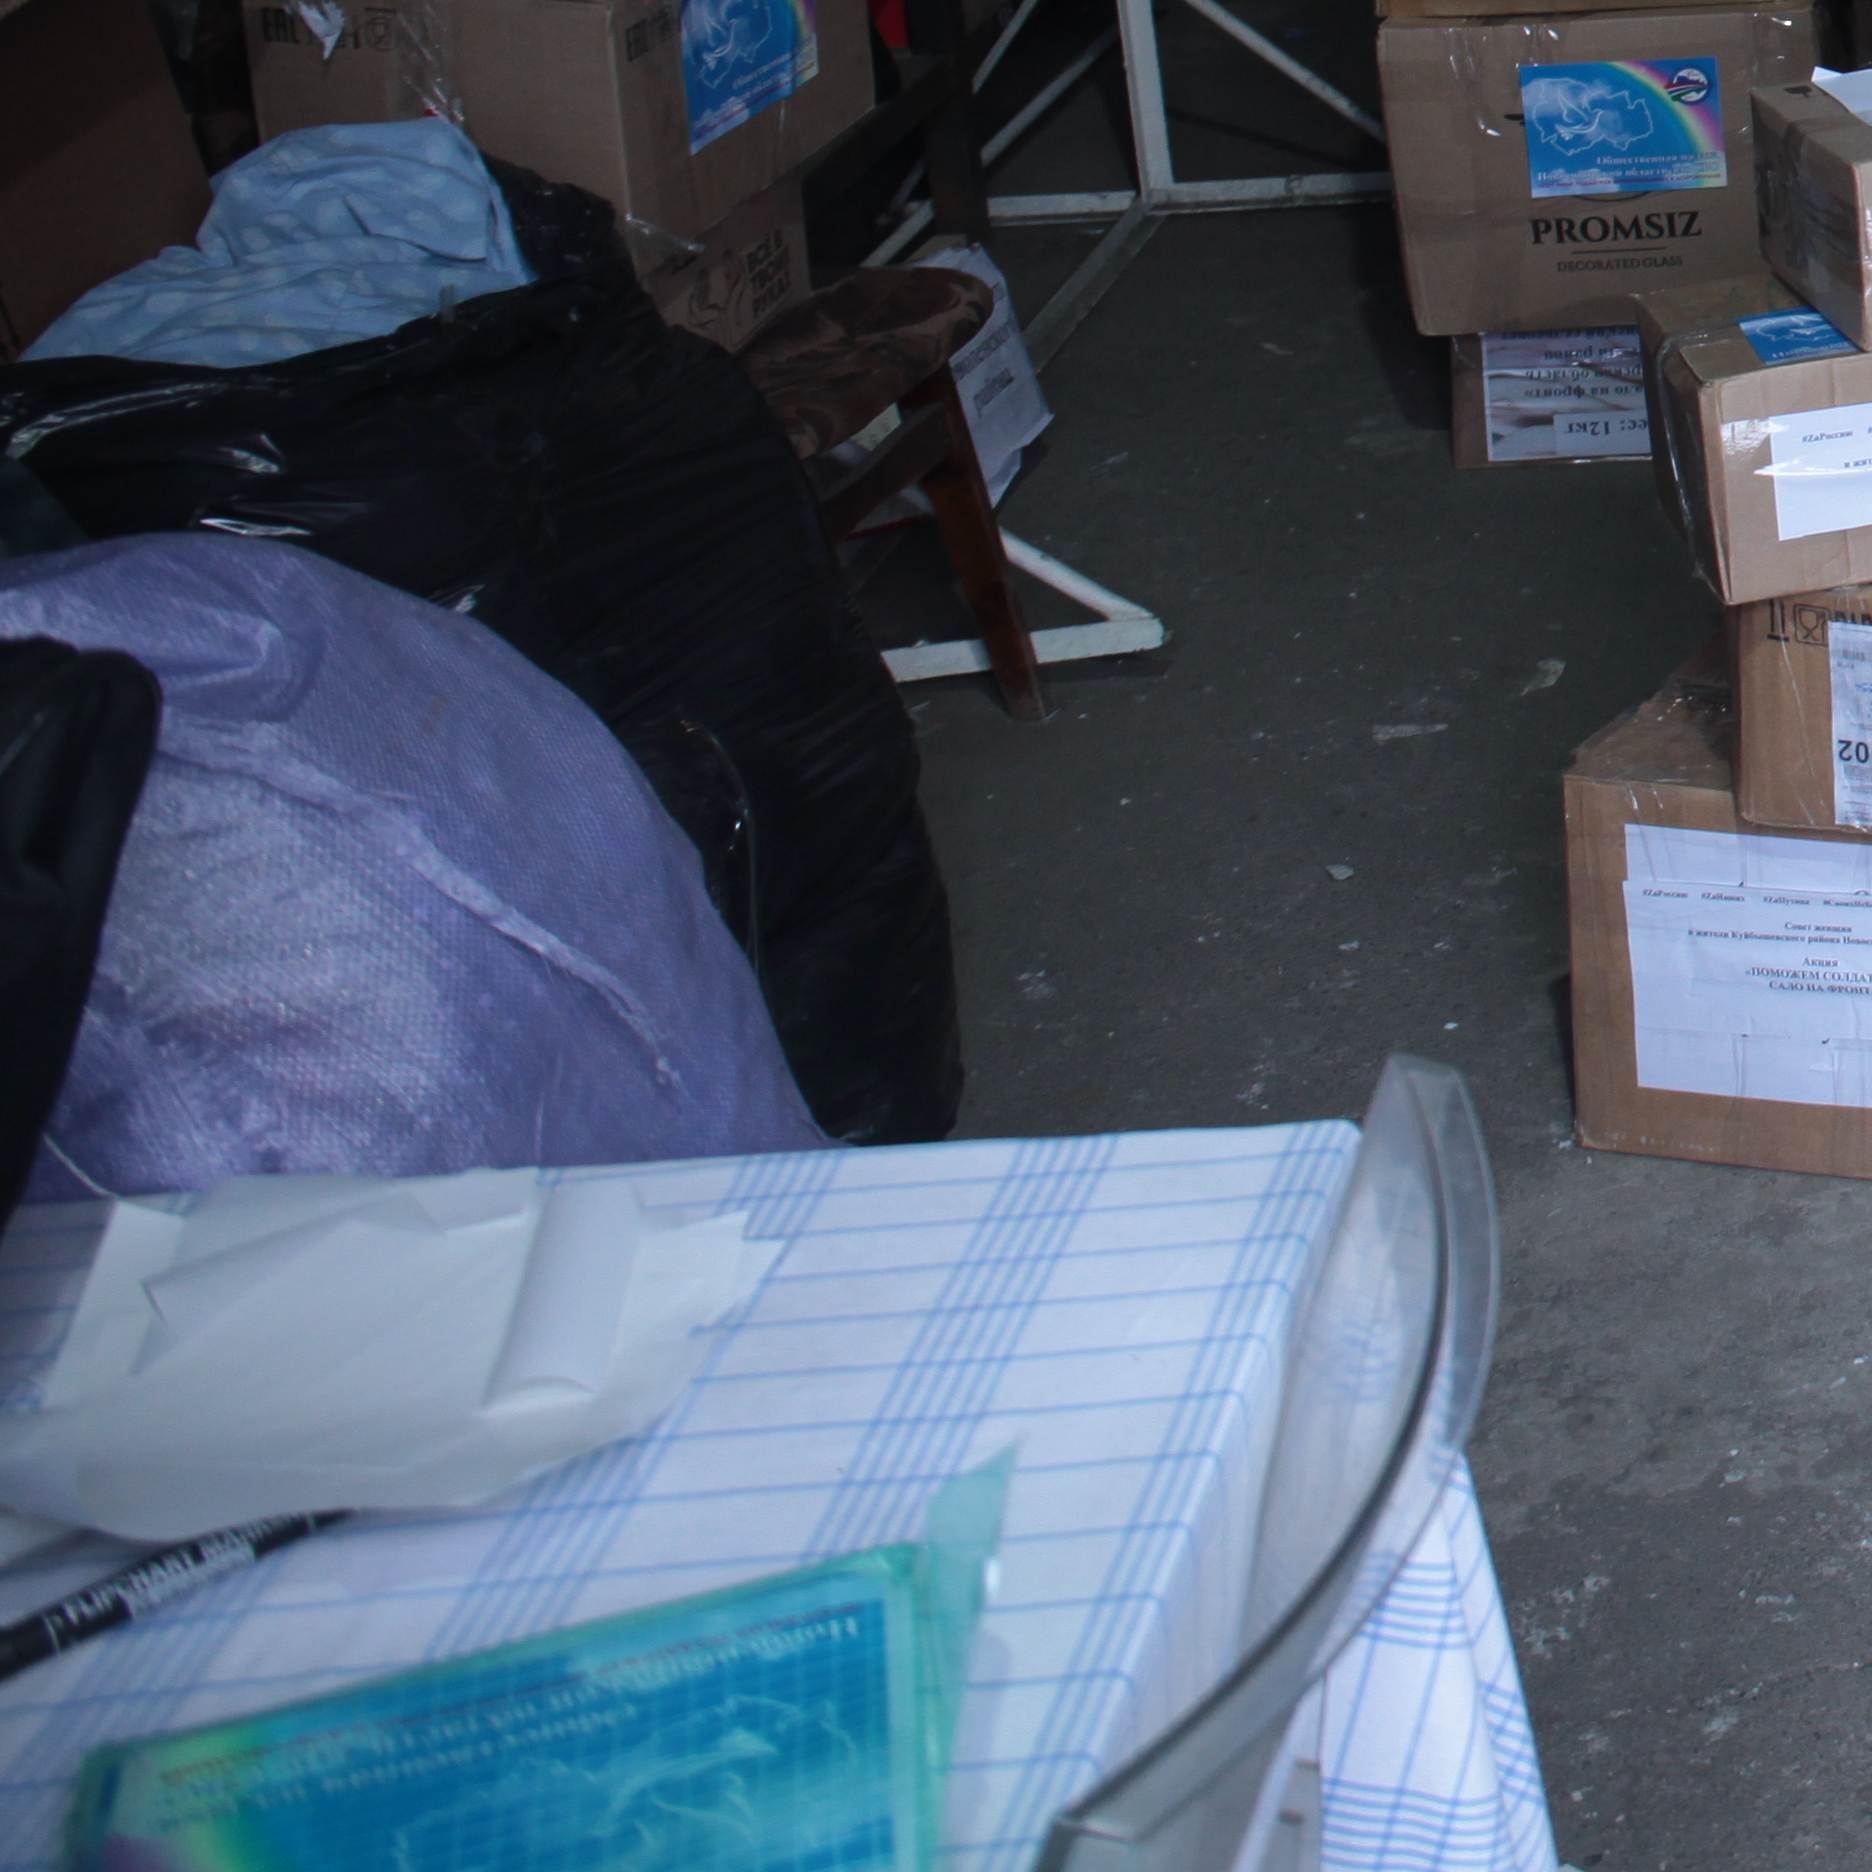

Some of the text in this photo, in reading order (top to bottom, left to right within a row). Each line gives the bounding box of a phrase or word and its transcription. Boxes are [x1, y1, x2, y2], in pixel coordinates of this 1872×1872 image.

[1529, 209, 1703, 246] PROMSIZ
[1556, 254, 1684, 273] DECORATED GLASS
[1524, 385, 1609, 398] фронт» на
[1563, 420, 1612, 437] 12кг
[1802, 956, 1839, 969] Акция
[1745, 966, 1821, 981] «ПОМОЖЕМ
[62, 1543, 199, 1626] FLIPCHART
